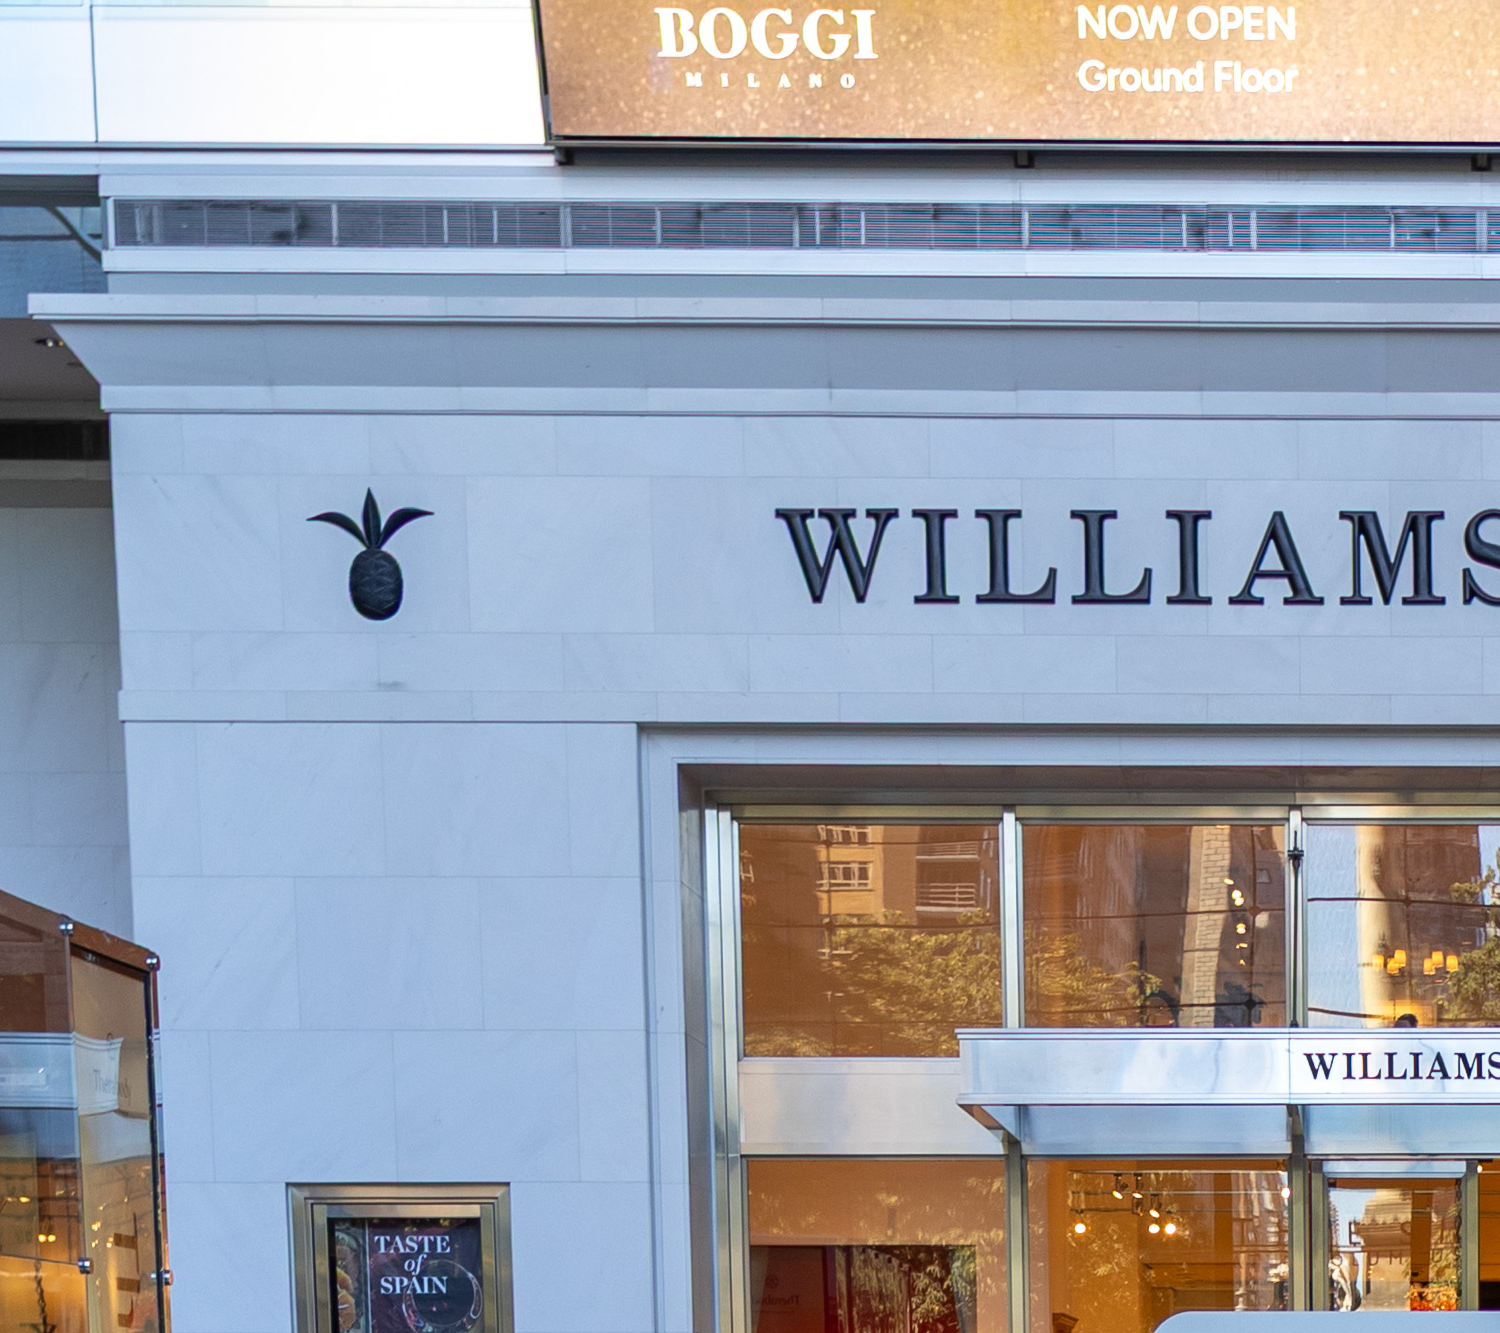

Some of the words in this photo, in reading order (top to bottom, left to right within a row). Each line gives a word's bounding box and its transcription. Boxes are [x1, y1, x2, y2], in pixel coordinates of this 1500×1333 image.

[656, 7, 877, 61] BOGGI
[1077, 6, 1174, 41] NOW
[1178, 7, 1296, 42] OPEN
[684, 71, 858, 89] MILANO
[1077, 59, 1202, 97] Ground
[1206, 59, 1299, 93] Floor
[374, 1236, 451, 1254] TASTE
[403, 1254, 427, 1276] of
[379, 1276, 449, 1295] SPAIN
